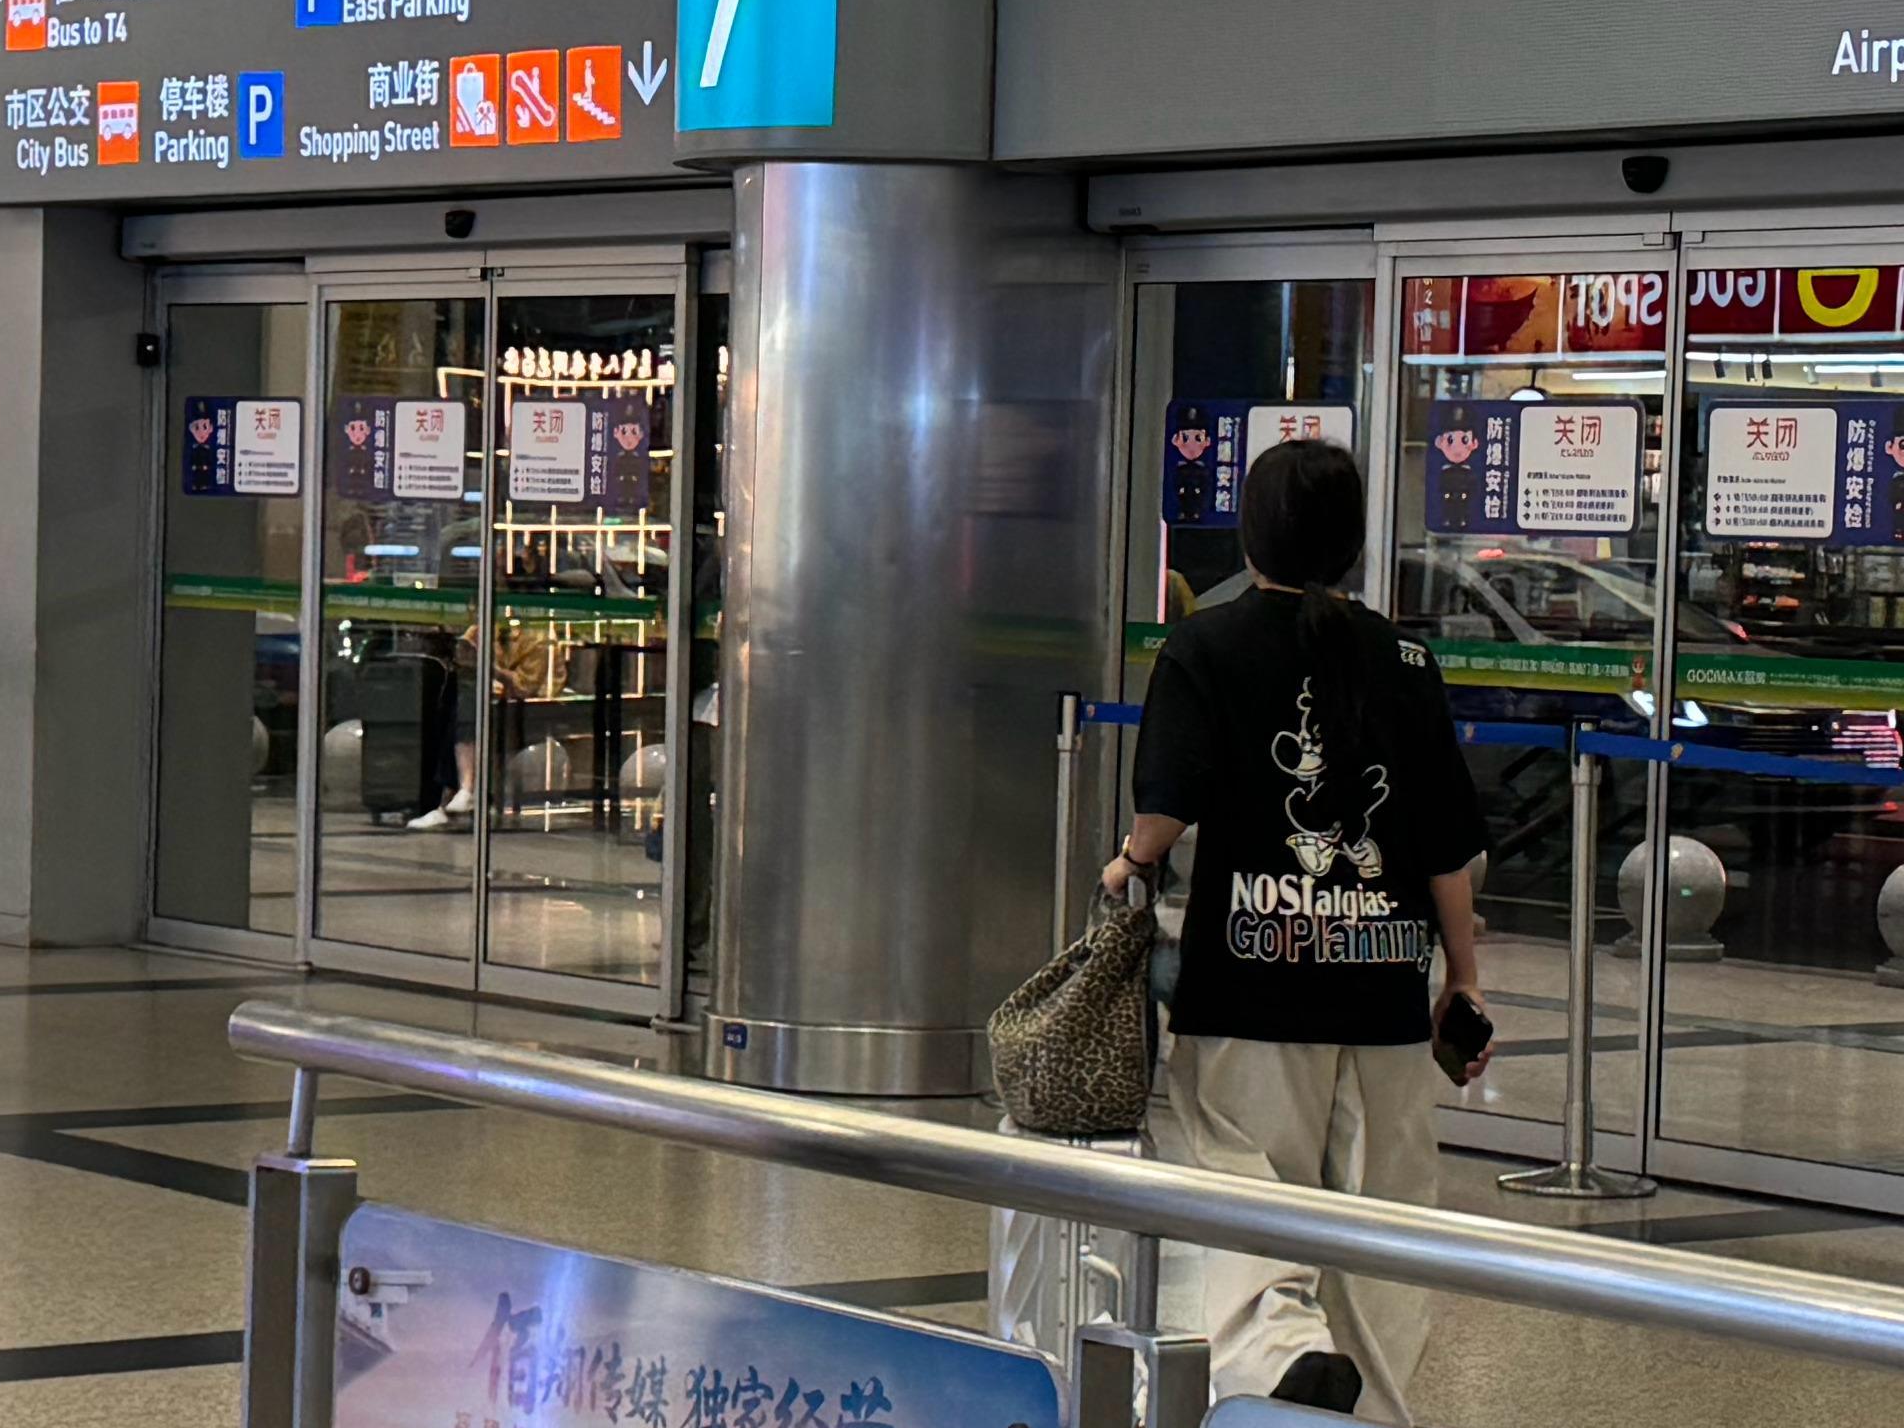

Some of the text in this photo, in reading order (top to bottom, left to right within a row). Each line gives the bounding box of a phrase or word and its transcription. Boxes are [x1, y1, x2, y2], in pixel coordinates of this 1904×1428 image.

[47, 12, 127, 48] Bus to T4
[160, 74, 229, 122] 停车楼
[368, 60, 439, 109] 商业街
[5, 85, 91, 130] 市区公交
[249, 85, 273, 145] P
[16, 136, 89, 175] City Bus
[155, 129, 229, 170] Parking
[300, 120, 440, 163] Shopping Street
[1554, 414, 1602, 446] 关闭
[1746, 416, 1798, 449] 关闭
